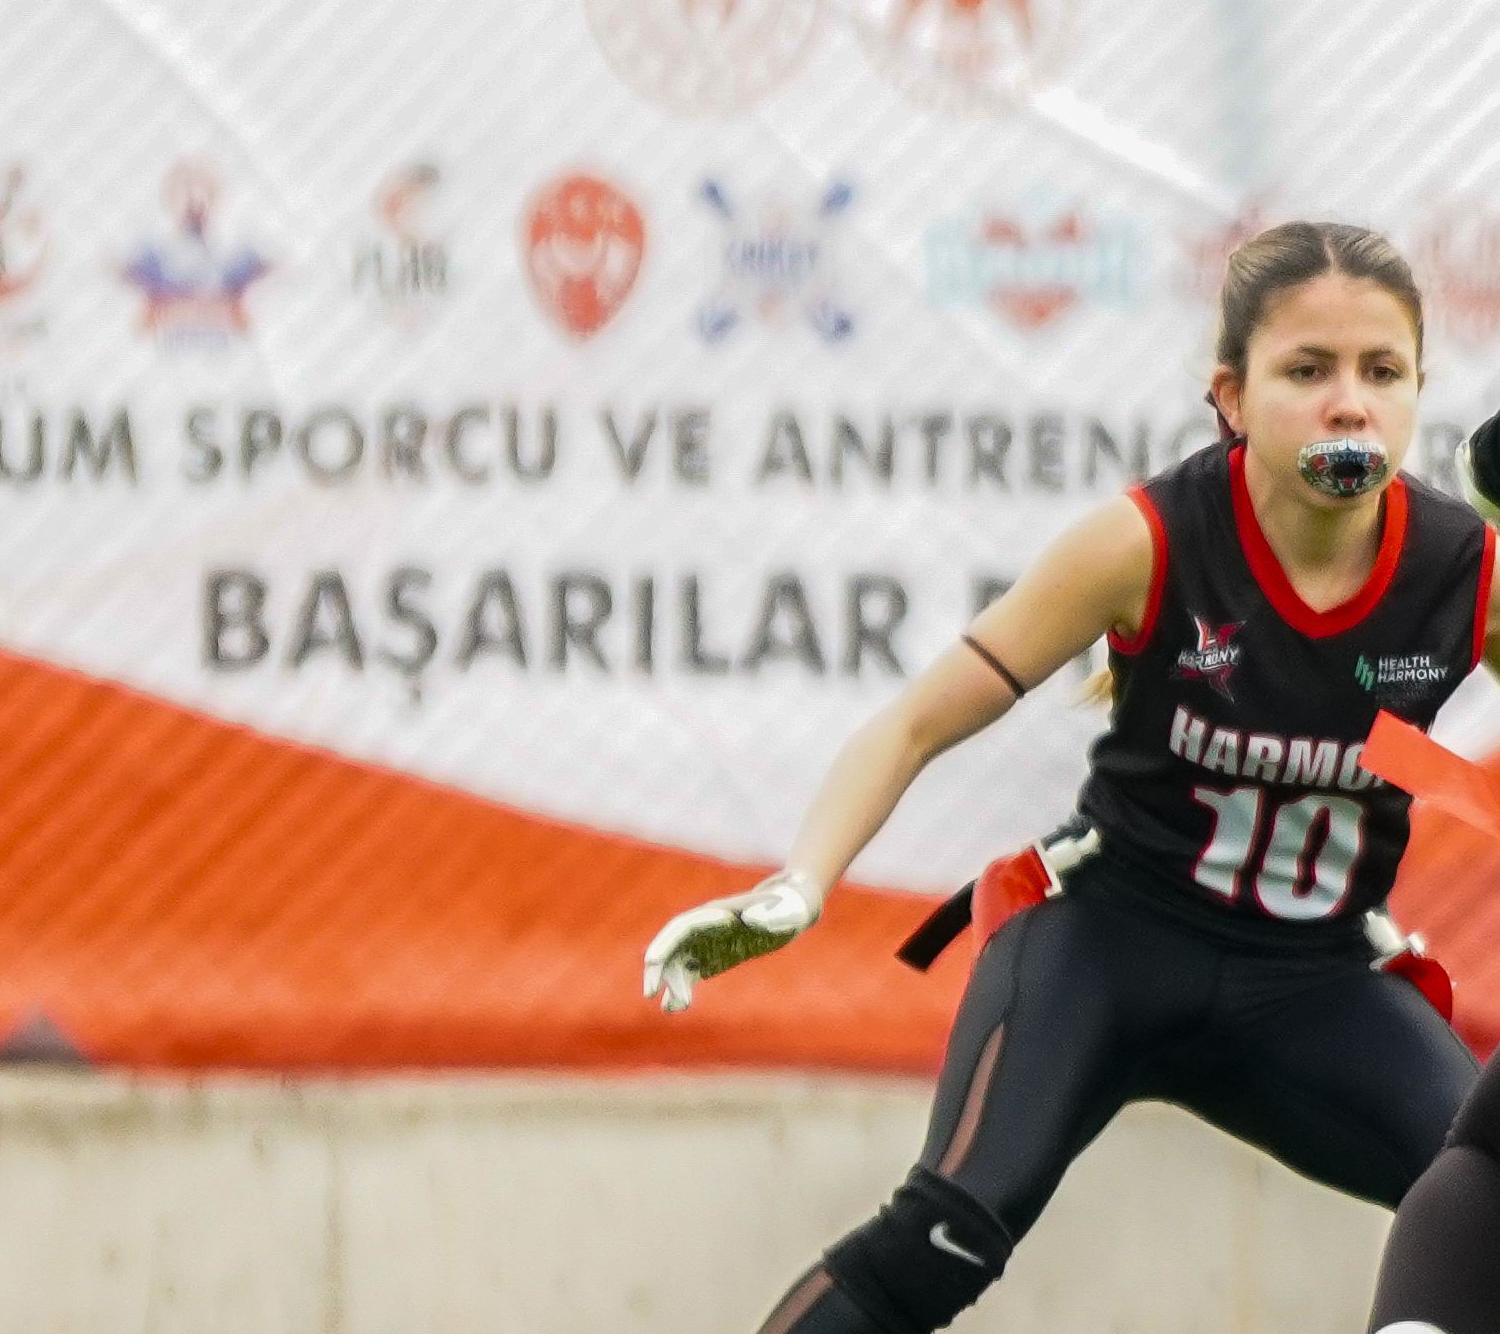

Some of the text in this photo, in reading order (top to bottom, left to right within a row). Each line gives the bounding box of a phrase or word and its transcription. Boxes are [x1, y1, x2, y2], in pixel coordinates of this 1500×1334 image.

[184, 402, 561, 485] SPORCU
[598, 405, 714, 487] VE
[204, 567, 910, 707] BAŞARILAR
[1376, 667, 1449, 684] HARMONY
[1378, 655, 1430, 671] HEALTH
[1168, 704, 1385, 789] HARMO
[1192, 785, 1366, 921] 10
